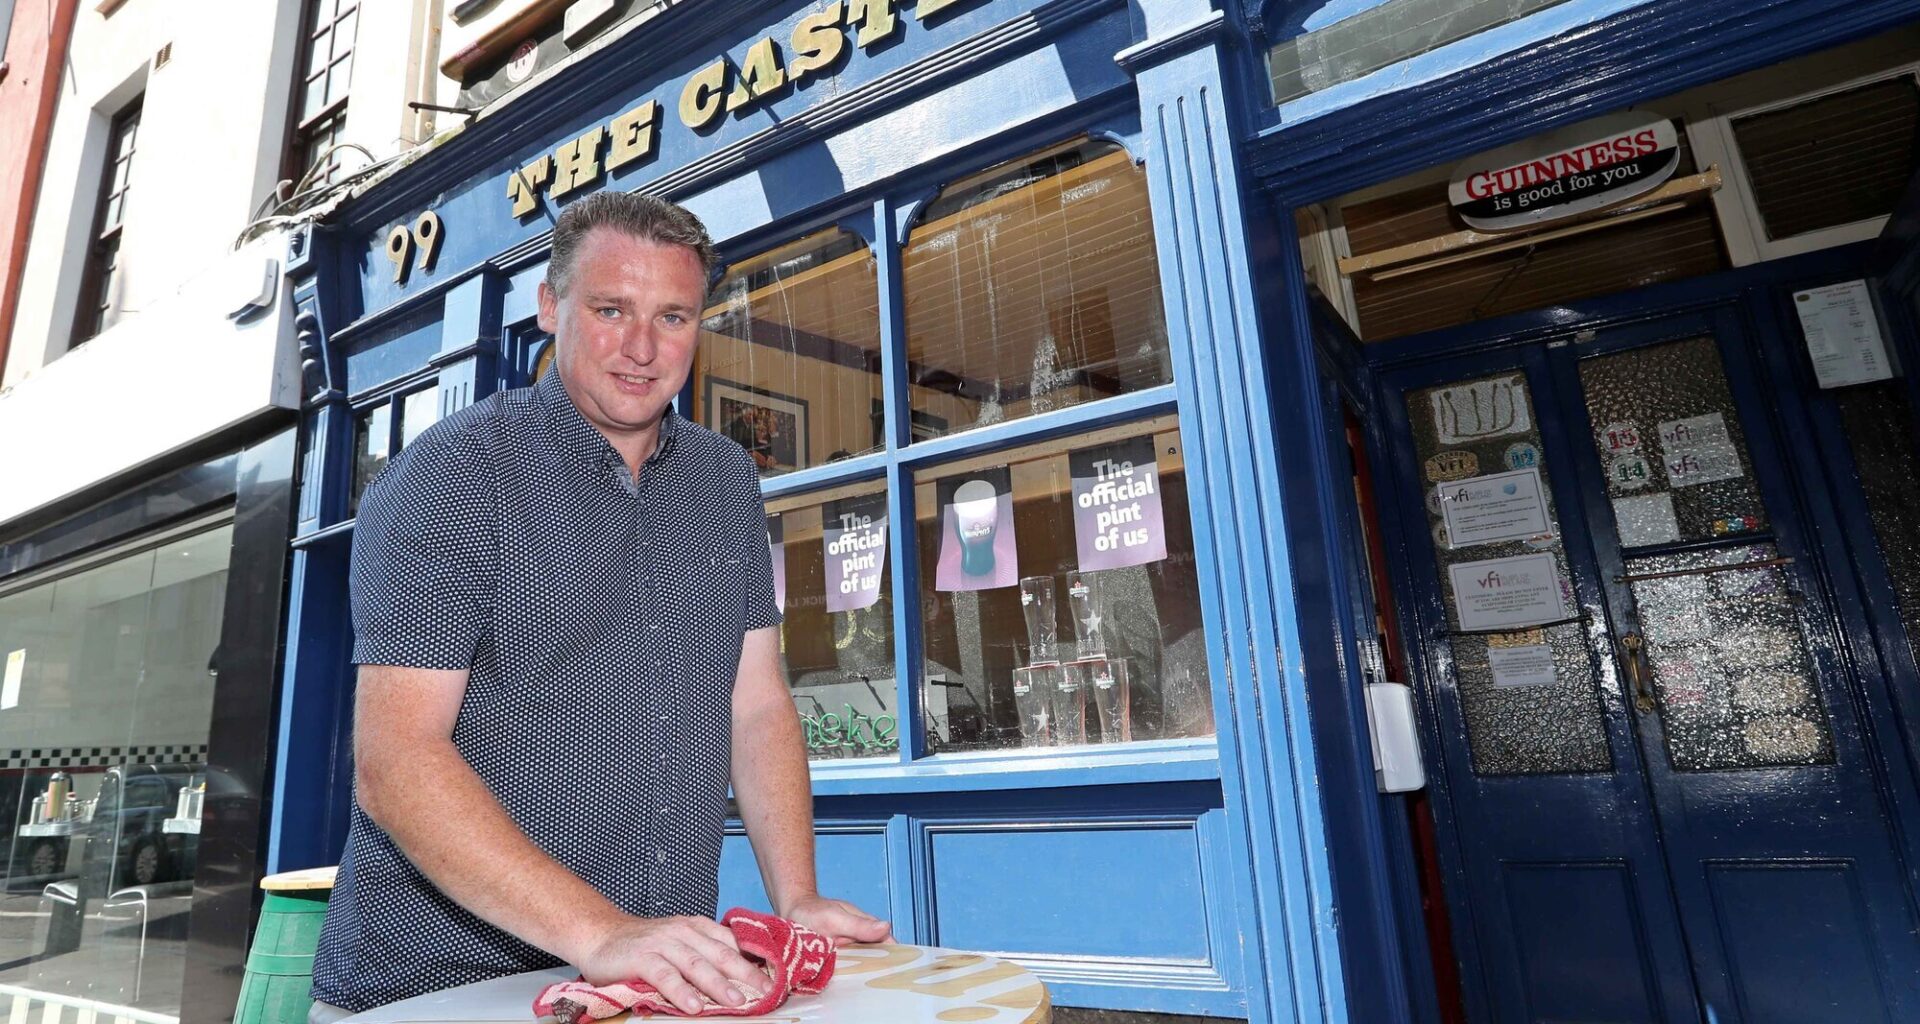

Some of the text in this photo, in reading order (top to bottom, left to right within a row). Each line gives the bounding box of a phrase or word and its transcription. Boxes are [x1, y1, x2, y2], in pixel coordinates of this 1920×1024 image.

[507, 99, 656, 219] THE
[1465, 130, 1658, 200] GUINNESS
[1494, 163, 1640, 211] is good for you
[386, 210, 438, 284] 99
[1092, 459, 1134, 482] The
[1078, 473, 1154, 508] official
[840, 512, 872, 532] The
[1097, 502, 1142, 534] pint
[828, 527, 884, 555] official
[1095, 527, 1148, 551] of us
[842, 552, 875, 578] pint
[840, 574, 877, 594] of us
[1477, 571, 1501, 588] vfi
